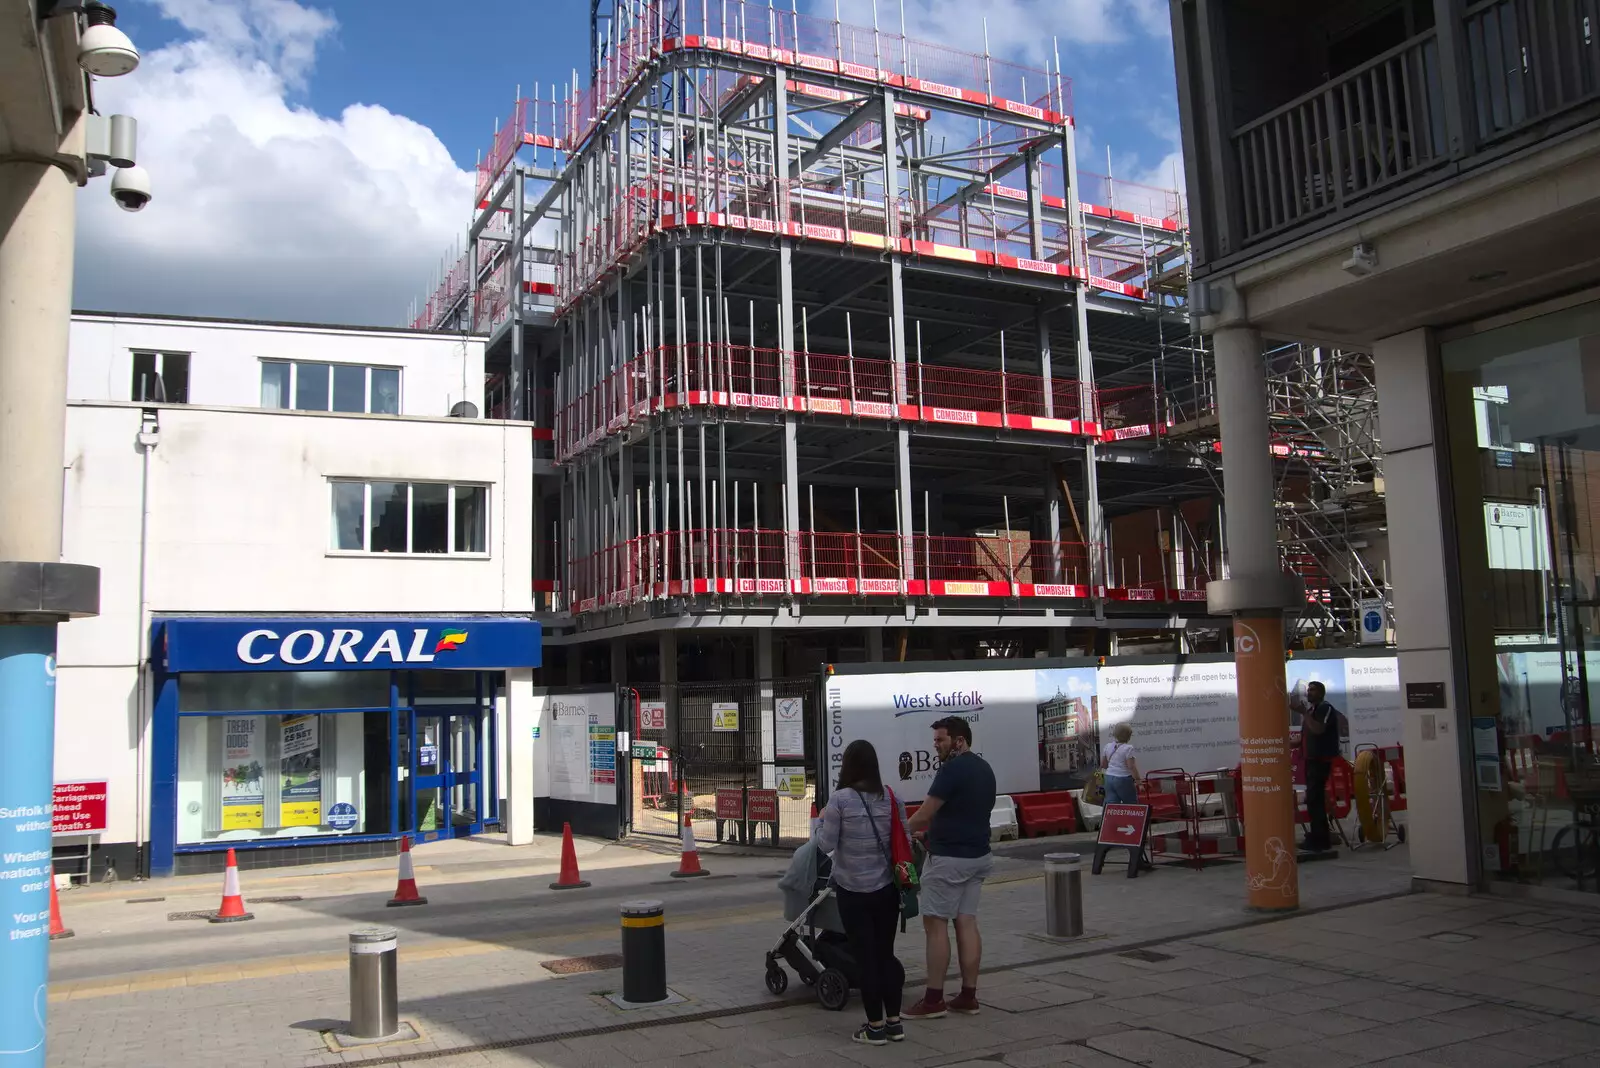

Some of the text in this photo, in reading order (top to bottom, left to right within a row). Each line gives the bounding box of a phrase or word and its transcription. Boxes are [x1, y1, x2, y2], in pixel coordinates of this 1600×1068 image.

[798, 55, 833, 71] OMBISAFE
[842, 63, 876, 79] COMBISA
[921, 81, 960, 97] COMBISAFE
[1008, 102, 1042, 118] COMBISAFE
[1135, 215, 1161, 227] CMBISAFE
[797, 224, 837, 239] CMBISAFE
[1019, 259, 1054, 273] COMBISAFE
[1090, 276, 1122, 292] COMBISAFE
[854, 402, 892, 415] OMBISAFE
[935, 409, 974, 422] COMBISAFE
[816, 581, 848, 592] OMBISA
[862, 580, 898, 592] OMBISAFE
[1036, 584, 1072, 597] COMBISAFE
[1129, 589, 1154, 600] COMBIS
[1180, 590, 1207, 600] COMBISA
[237, 629, 436, 664] CORAL
[1106, 677, 1120, 687] Bury
[1122, 676, 1129, 684] St
[1130, 675, 1161, 684] Edmunds
[1190, 673, 1201, 681] still
[1202, 674, 1219, 683] open
[1228, 671, 1237, 680] bu
[893, 690, 983, 709] West Suffolk
[559, 702, 586, 716] Barnes
[829, 688, 843, 748] Cornhill
[1249, 737, 1284, 745] delivered
[1244, 746, 1284, 755] counselling
[1246, 756, 1259, 764] last
[1259, 757, 1279, 766] year.
[0, 805, 43, 819] Suffolk
[53, 812, 91, 822] ase Use
[1107, 808, 1145, 817] PEDESTRIANS
[21, 882, 43, 893] one
[13, 909, 49, 924] You ca
[10, 928, 41, 940] there
